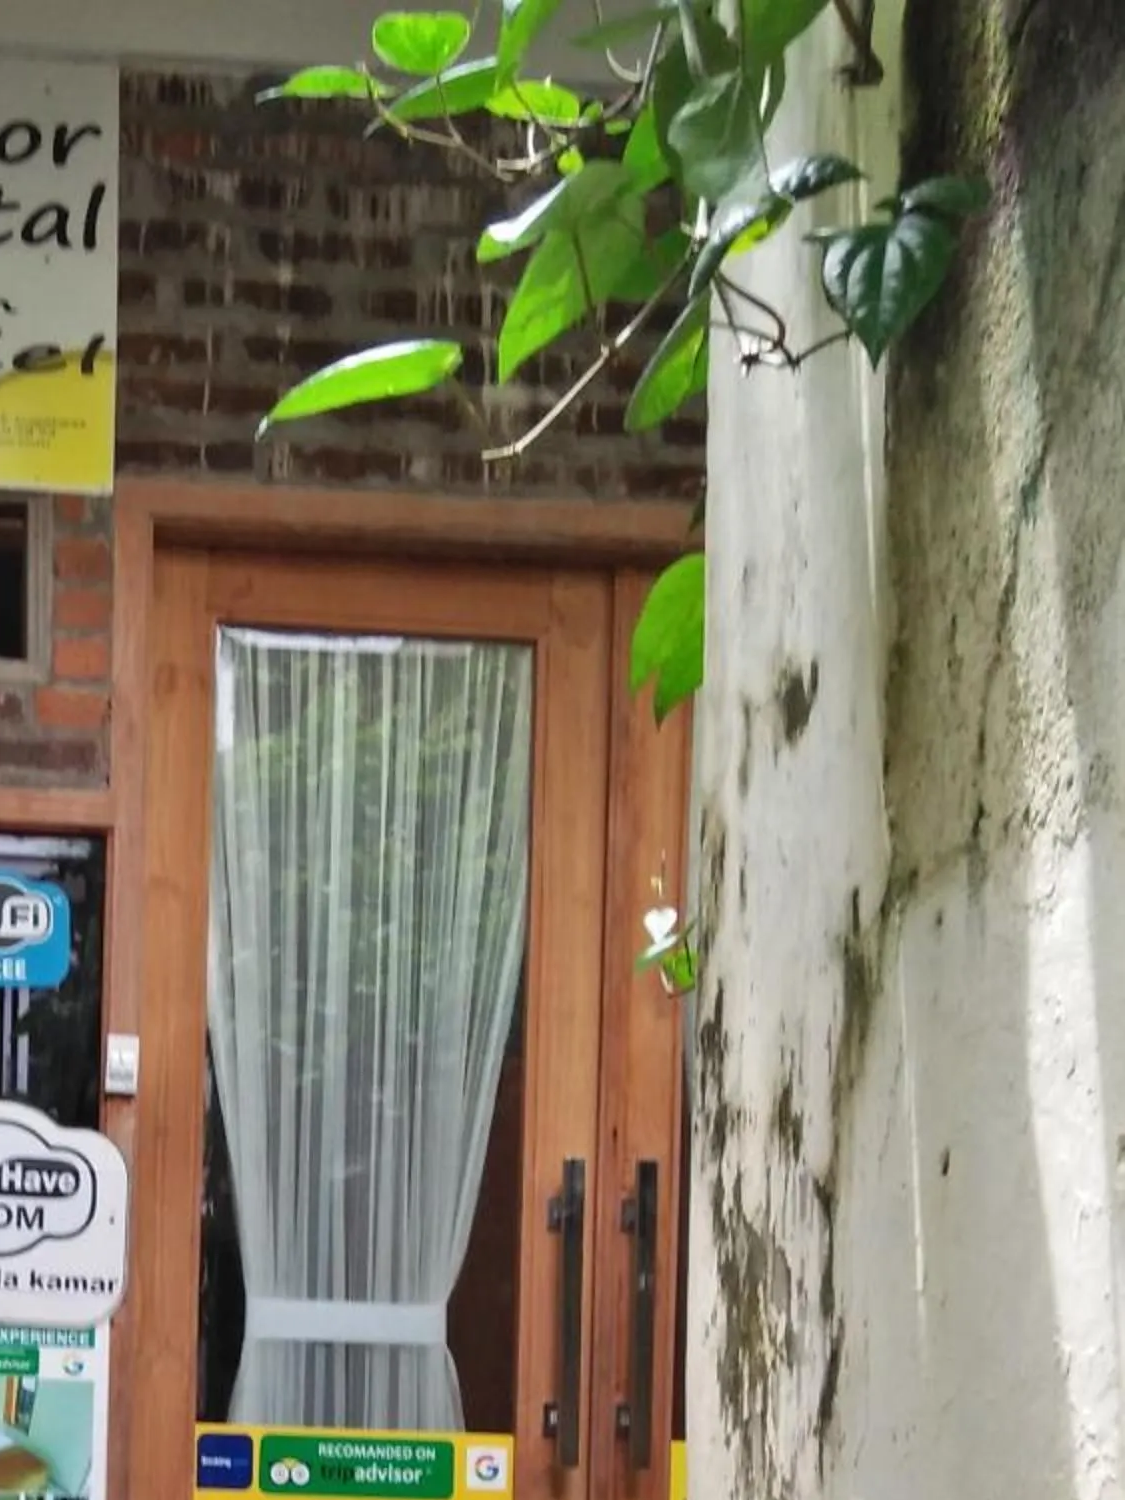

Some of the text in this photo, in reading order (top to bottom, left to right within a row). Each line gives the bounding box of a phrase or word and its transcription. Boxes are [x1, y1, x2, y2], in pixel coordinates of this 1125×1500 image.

[1, 1160, 76, 1195] Have
[28, 1268, 117, 1296] kamar
[318, 1442, 436, 1460] RECOMANDED ON
